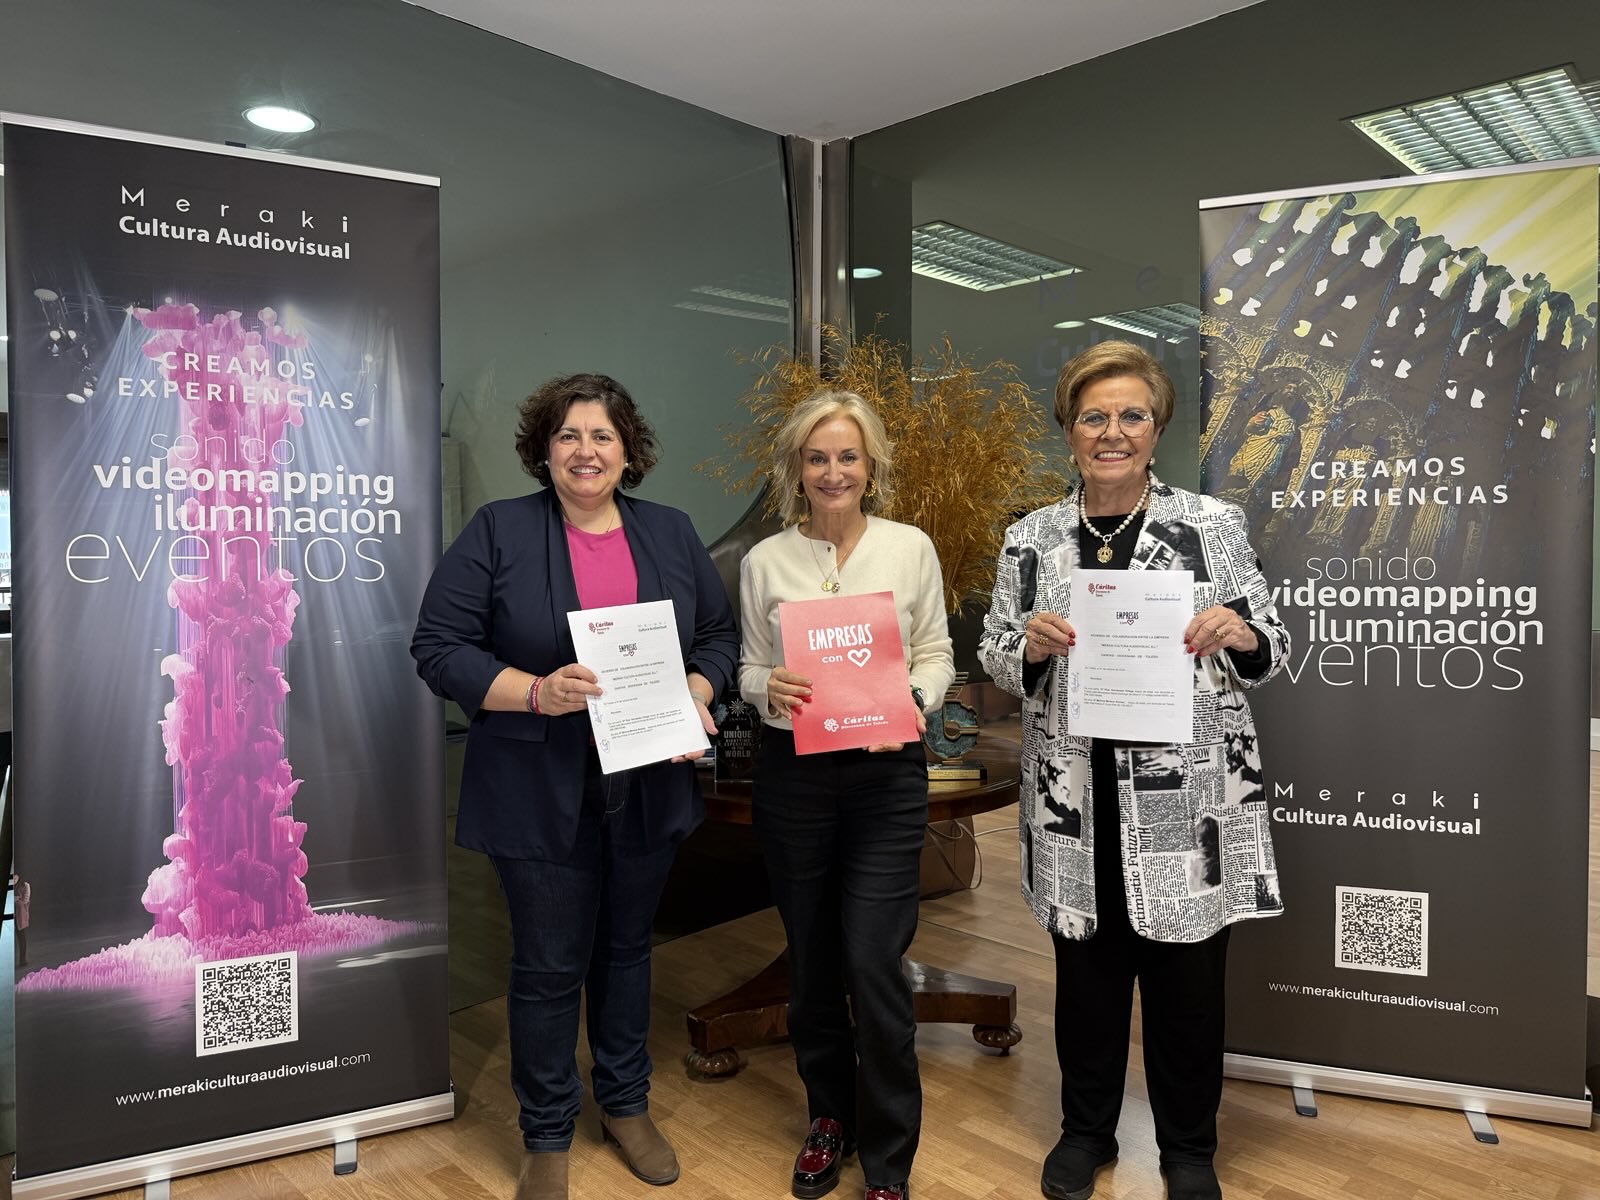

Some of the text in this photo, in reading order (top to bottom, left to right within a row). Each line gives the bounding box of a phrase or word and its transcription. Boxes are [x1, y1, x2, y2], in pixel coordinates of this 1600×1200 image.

[121, 185, 348, 233] Meraki
[118, 215, 351, 259] Cultura Audiovisual
[160, 351, 316, 379] CREAMOS
[118, 377, 355, 410] EXPERIENCIAS
[150, 429, 296, 464] sonido
[93, 457, 395, 504] videomapping
[1310, 456, 1466, 480] CREAMOS
[1270, 484, 1509, 509] EXPERIENCIAS
[154, 494, 402, 534] iluminación
[65, 527, 386, 583] eventos
[1306, 548, 1437, 581] sonido
[1116, 611, 1139, 620] EMPRESAS
[1308, 609, 1544, 645] iluminación
[807, 623, 873, 651] EMPRESAS
[821, 654, 843, 664] con
[1285, 635, 1524, 691] ventos
[843, 714, 885, 725] Cáritas
[723, 730, 753, 739] UNIQUE
[724, 750, 751, 758] WORLD
[1193, 747, 1210, 760] NOW
[1274, 781, 1480, 810] Meraki
[1191, 804, 1240, 823] Optimistic
[1272, 807, 1481, 835] Cultura Audiovisual
[1044, 829, 1078, 848] Future
[1137, 825, 1153, 854] TRUTH
[1128, 824, 1149, 938] Optimistic Future
[1268, 981, 1500, 1016] www.merakiculturaaudiovisual.com
[115, 1052, 372, 1106] www.merakiculturaaudiovisual.com
